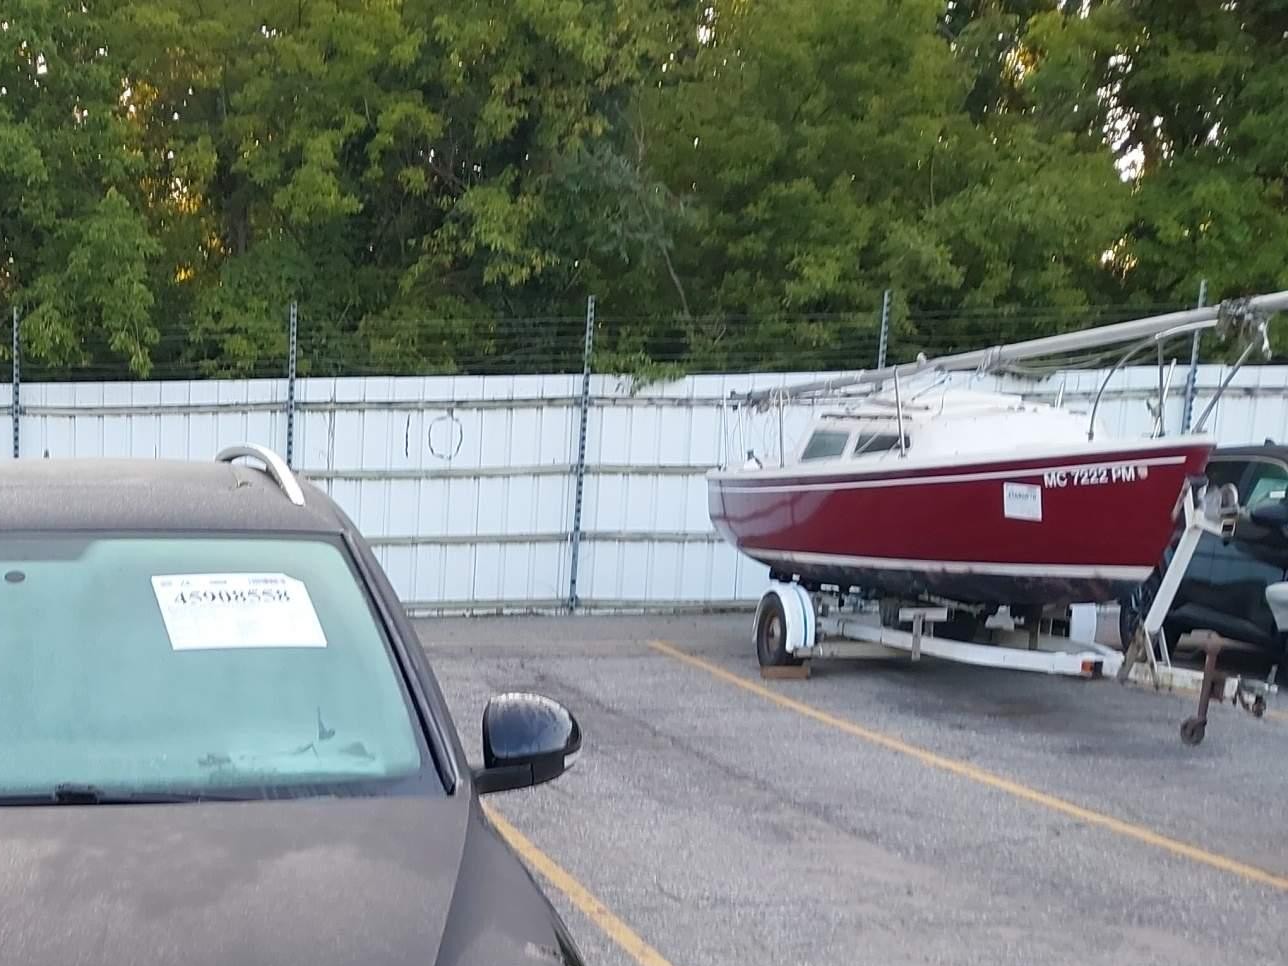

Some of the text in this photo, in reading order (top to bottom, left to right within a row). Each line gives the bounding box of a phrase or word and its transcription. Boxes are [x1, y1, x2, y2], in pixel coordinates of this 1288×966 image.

[1043, 464, 1136, 488] MC 7222 PM
[174, 588, 291, 604] 45908558
